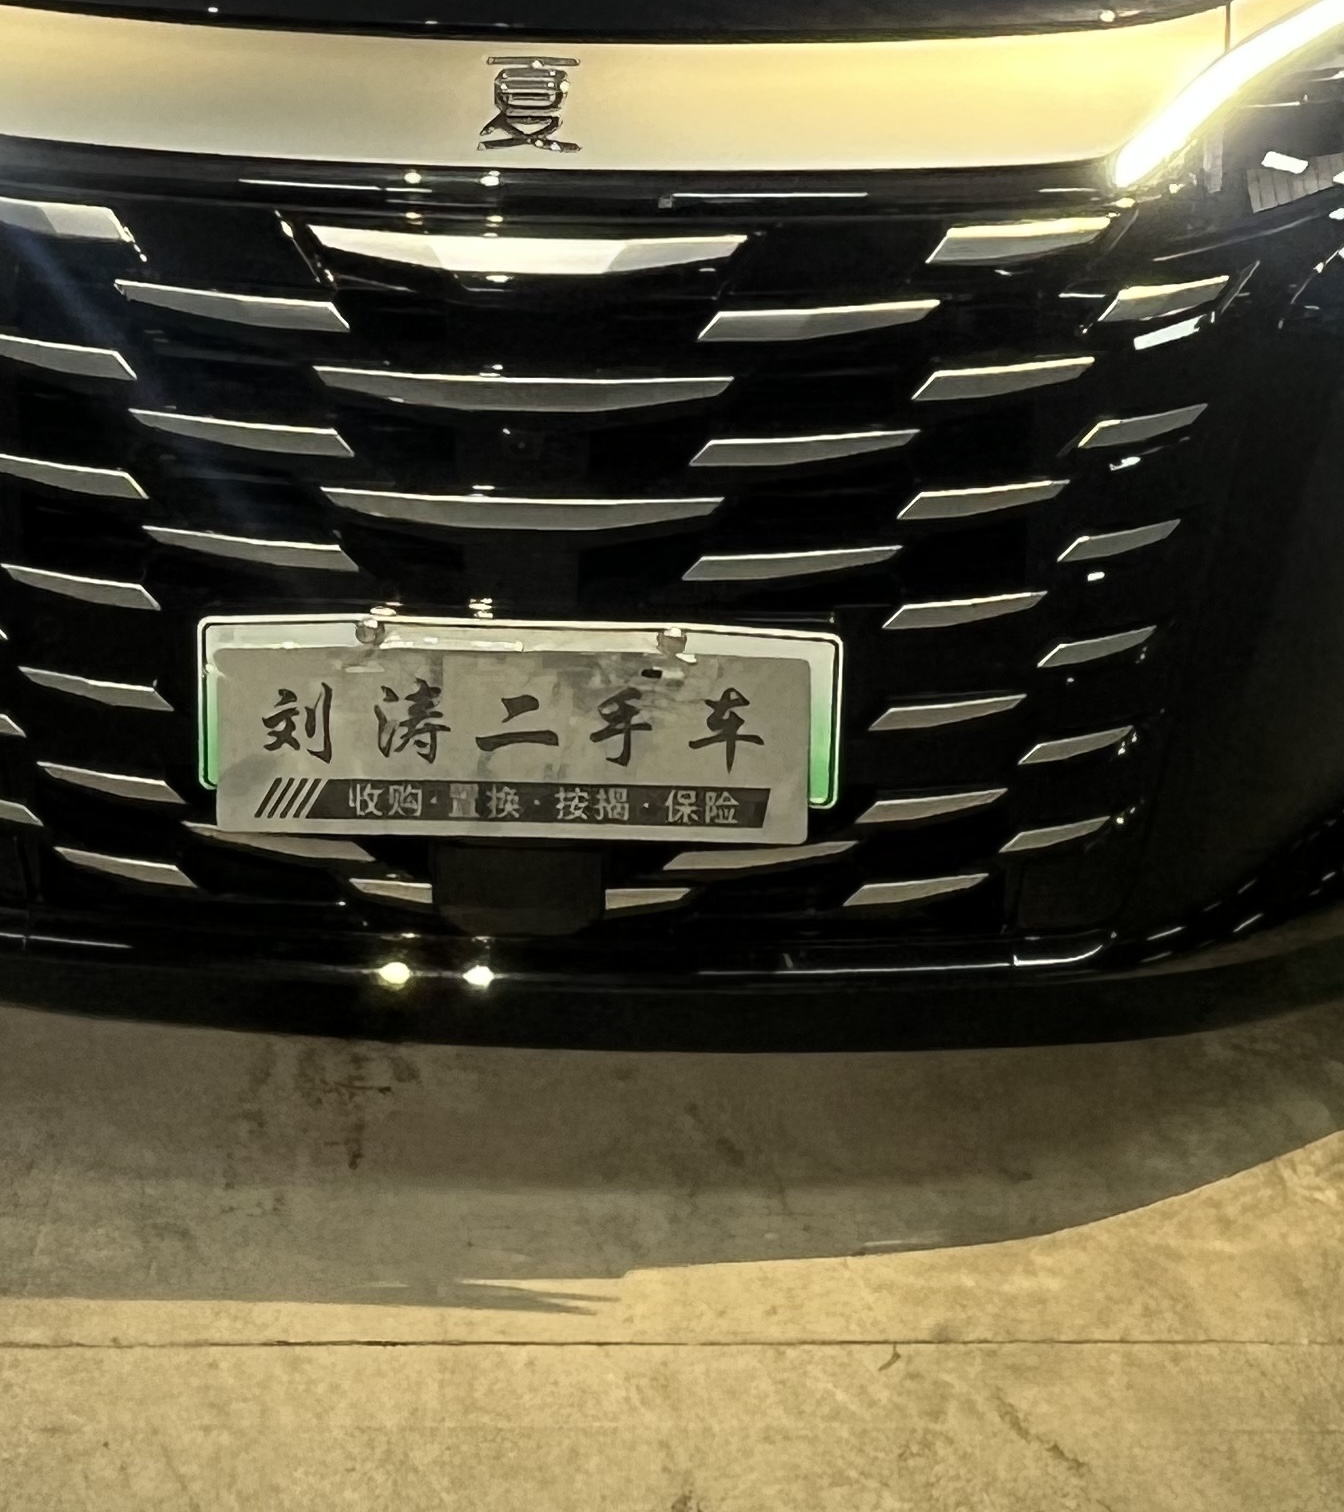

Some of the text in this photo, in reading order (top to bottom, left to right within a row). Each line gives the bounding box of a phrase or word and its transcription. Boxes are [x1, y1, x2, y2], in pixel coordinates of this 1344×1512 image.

[476, 55, 582, 153] 夏
[262, 678, 765, 773] 刘涛二手车
